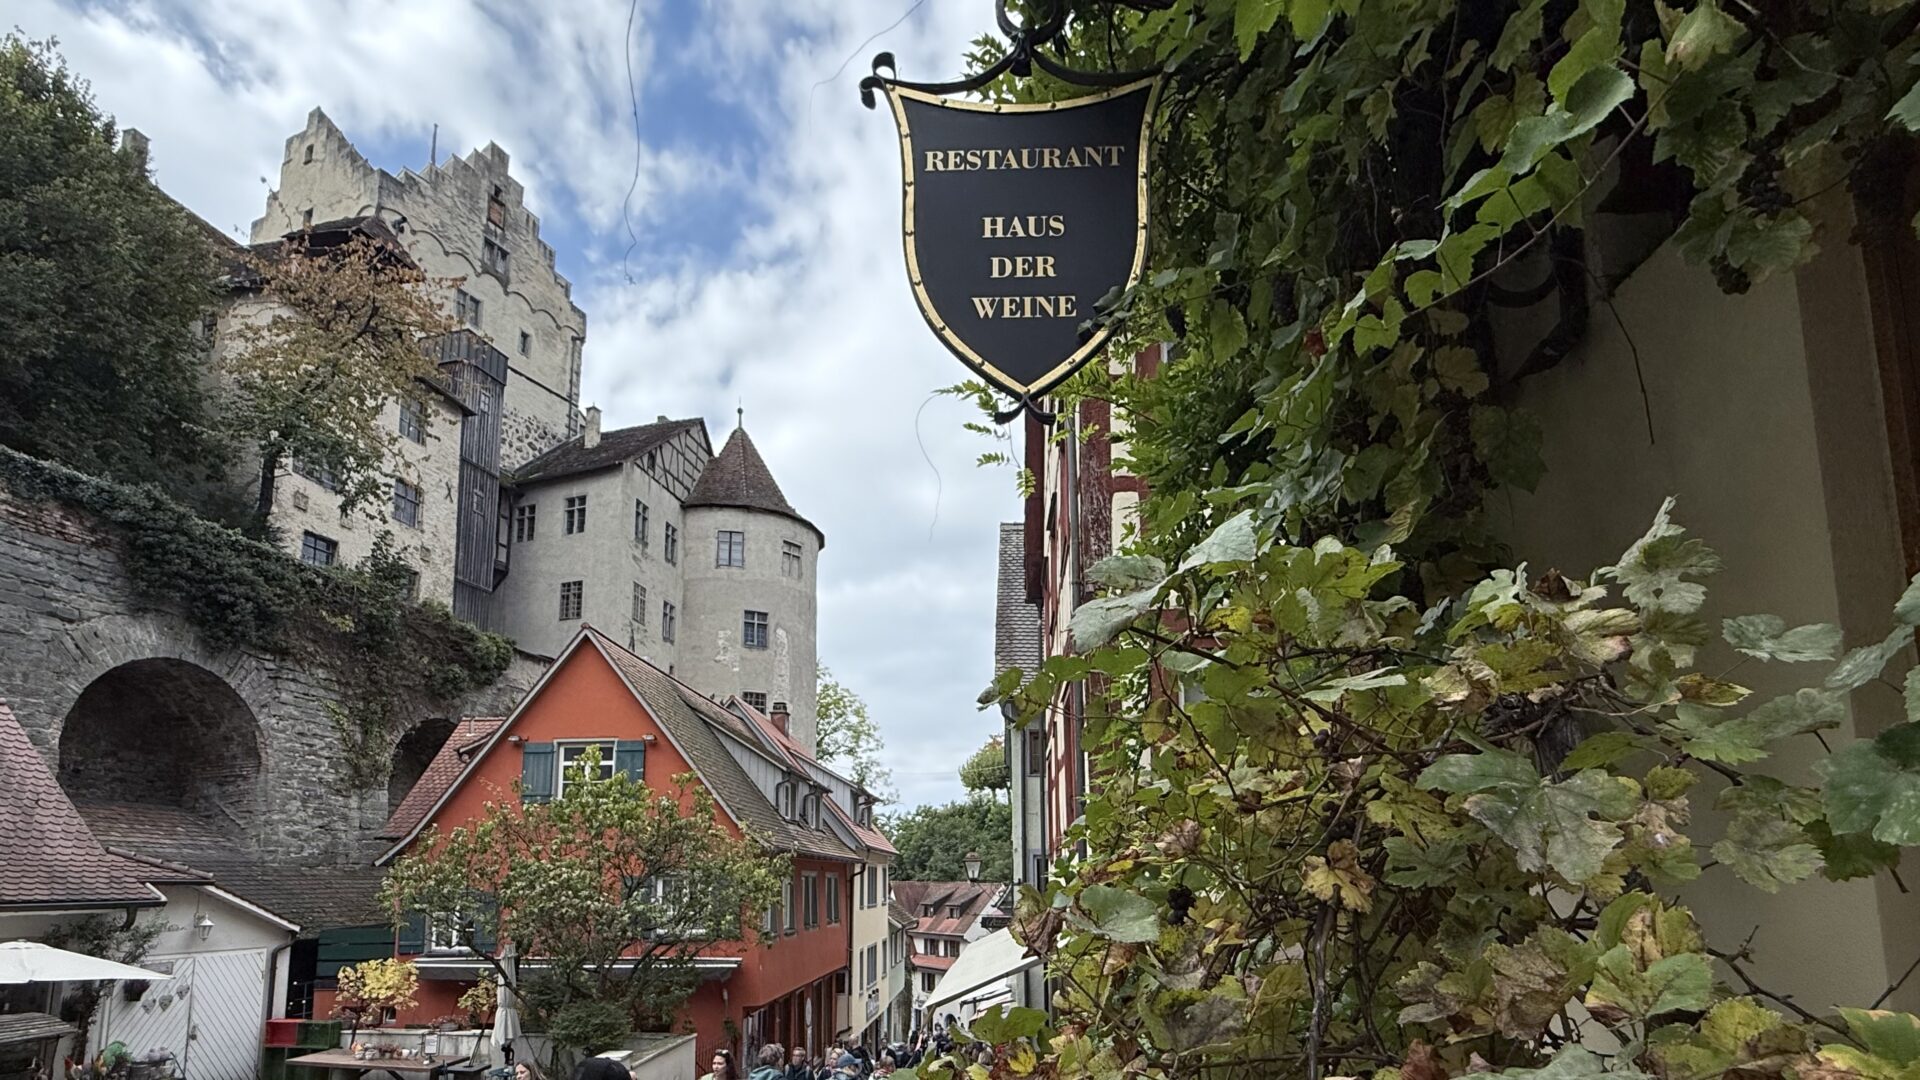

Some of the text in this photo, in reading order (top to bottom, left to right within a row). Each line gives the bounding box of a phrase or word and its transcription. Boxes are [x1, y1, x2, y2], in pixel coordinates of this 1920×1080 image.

[924, 146, 1125, 172] RESTAURANT
[981, 215, 1065, 239] HAUS
[990, 256, 1057, 279] DER
[971, 295, 1077, 319] WEINE
